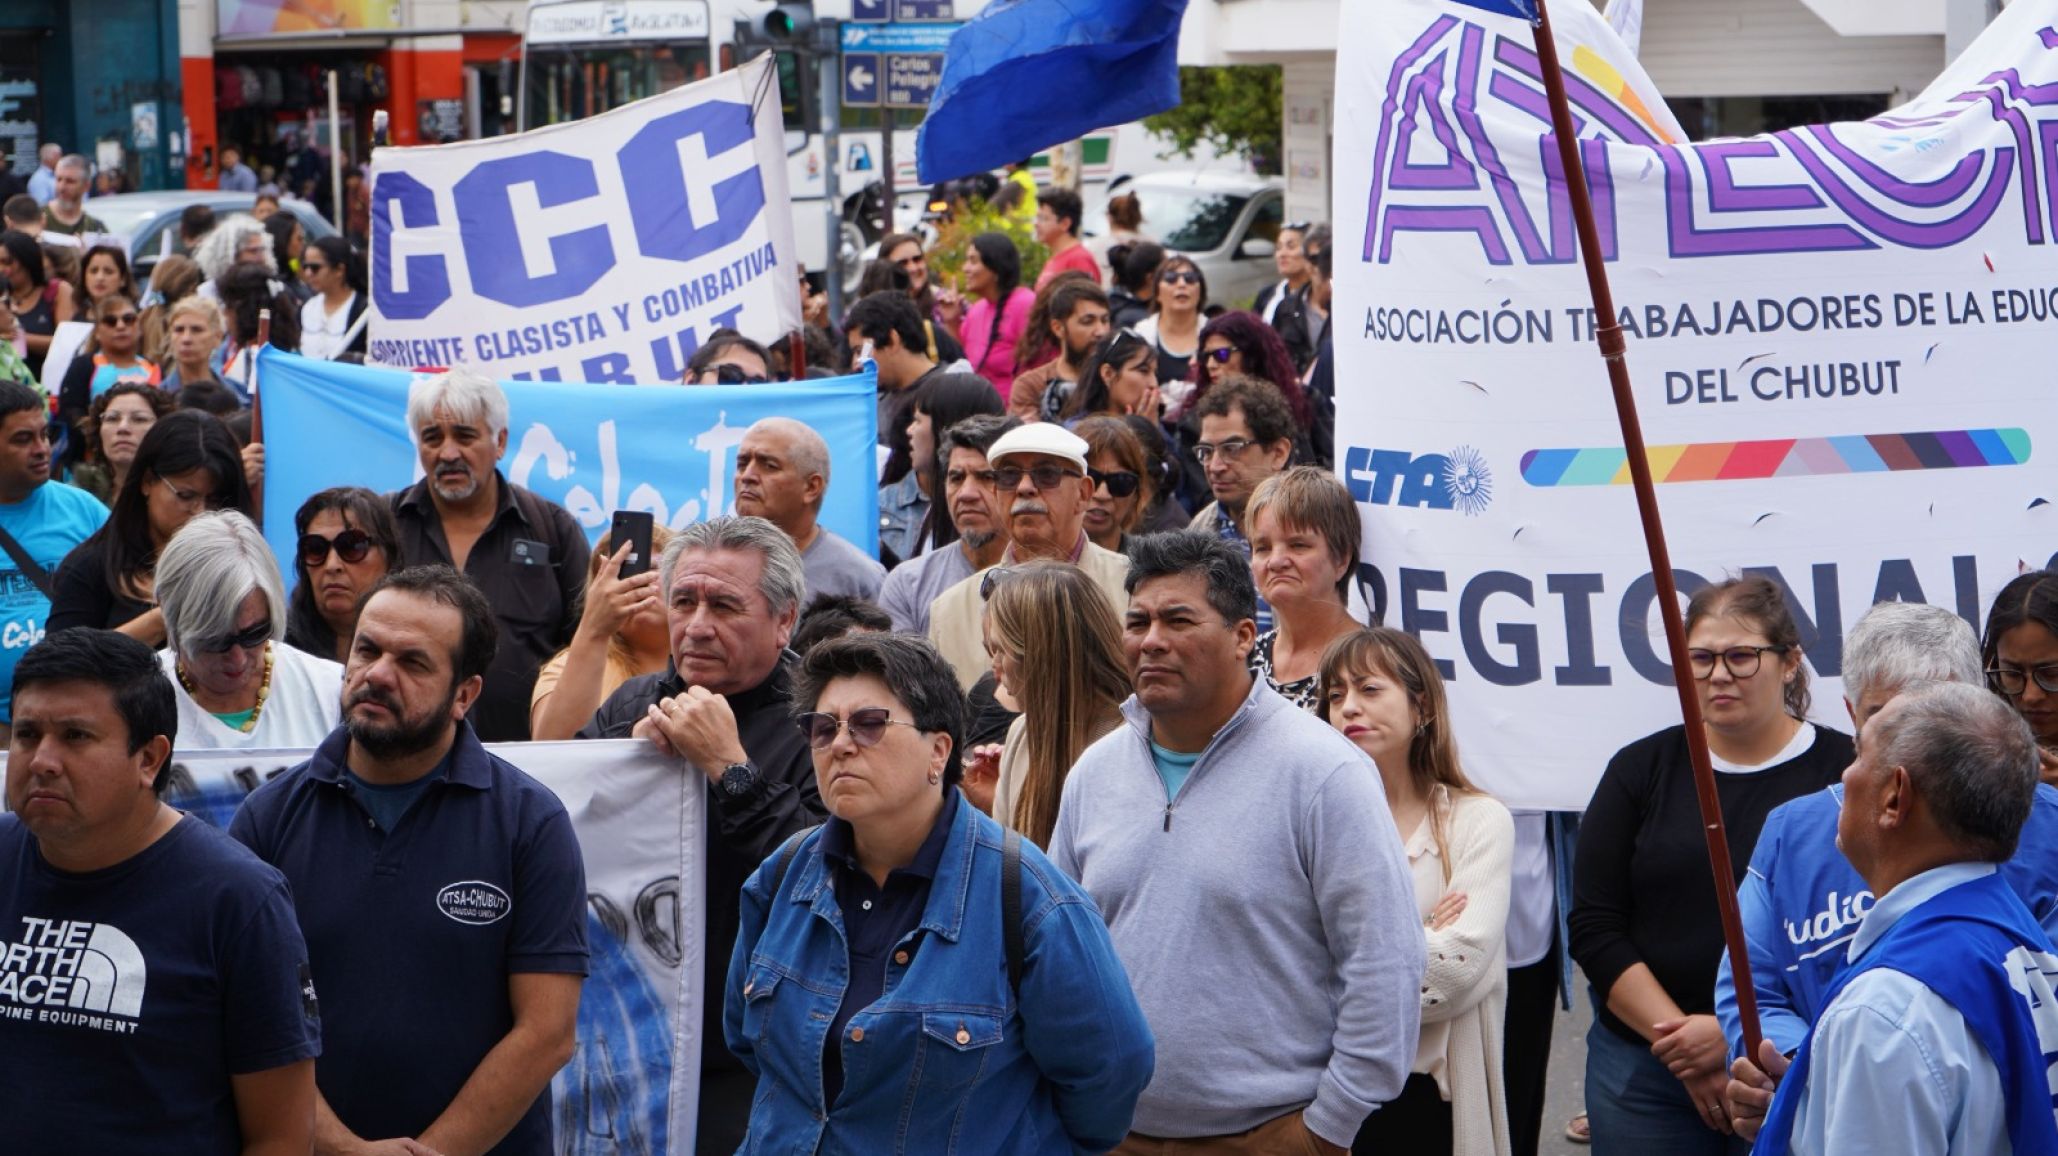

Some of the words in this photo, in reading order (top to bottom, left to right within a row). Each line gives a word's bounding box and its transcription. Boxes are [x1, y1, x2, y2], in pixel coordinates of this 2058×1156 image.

[890, 56, 930, 71] Carlos
[372, 99, 766, 320] CCC
[475, 311, 606, 362] CLASISTA
[612, 303, 631, 332] Y
[643, 242, 778, 323] COMBATIVA
[1364, 298, 1553, 345] ASOCIACIÓN
[1894, 292, 1936, 327] DE
[1945, 291, 1986, 325] LA
[1665, 368, 1739, 405] DEL
[1750, 360, 1901, 401] CHUBUT
[1345, 446, 1455, 510] CTA
[442, 889, 506, 909] ATSA-CHUBUT
[1784, 891, 1875, 944] udic
[22, 916, 93, 949] THE
[0, 970, 73, 1005] ACE
[39, 1009, 139, 1034] EQUIPMENT
